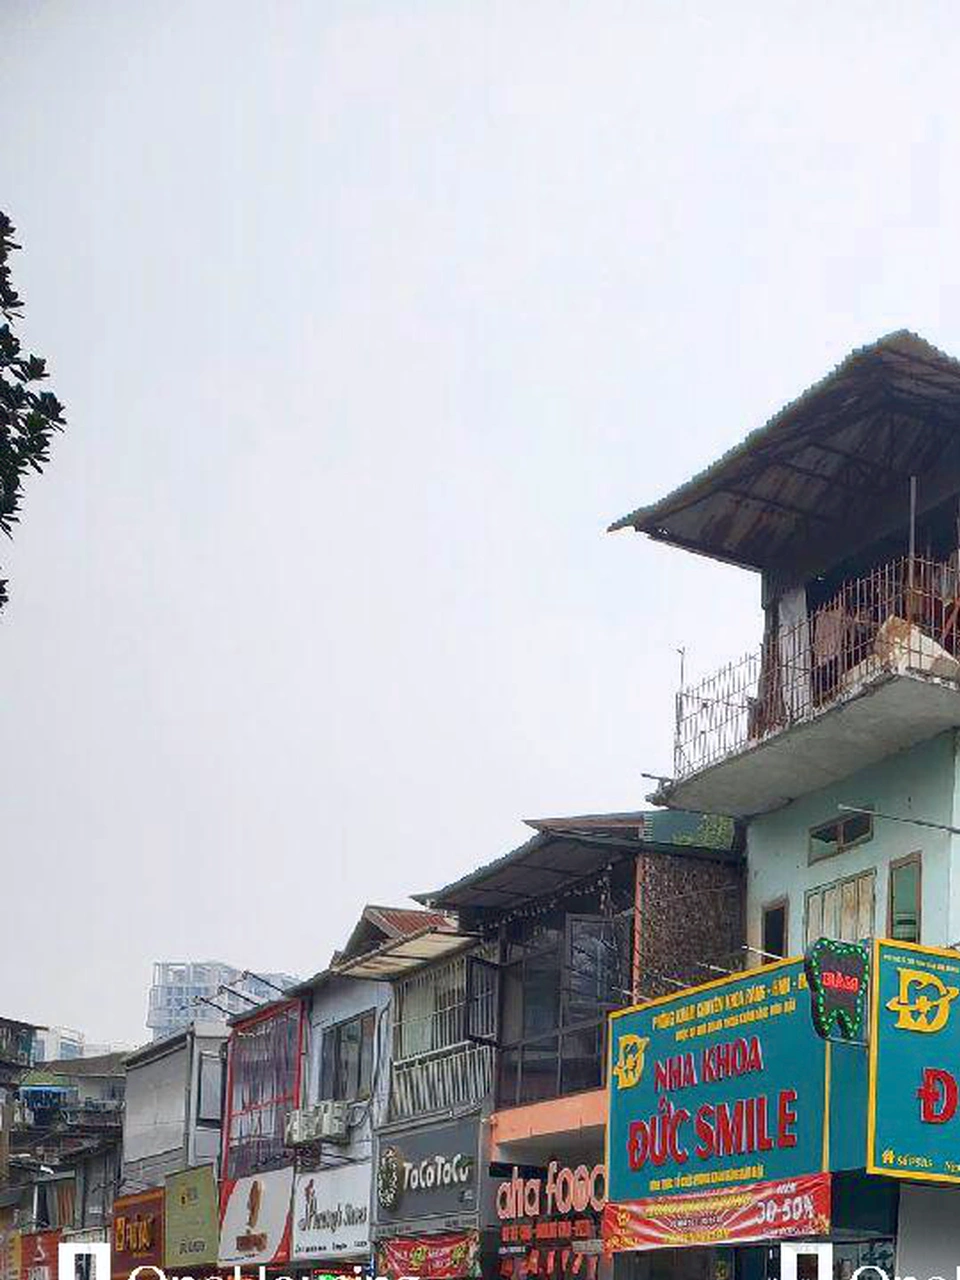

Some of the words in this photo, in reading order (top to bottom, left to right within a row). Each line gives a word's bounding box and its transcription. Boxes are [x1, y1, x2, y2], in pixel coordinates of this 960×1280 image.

[654, 1052, 698, 1092] NHA
[703, 1035, 763, 1083] KHOA
[626, 1096, 691, 1172] ĐỨC
[695, 1089, 797, 1161] SMILE
[496, 1166, 541, 1219] aha
